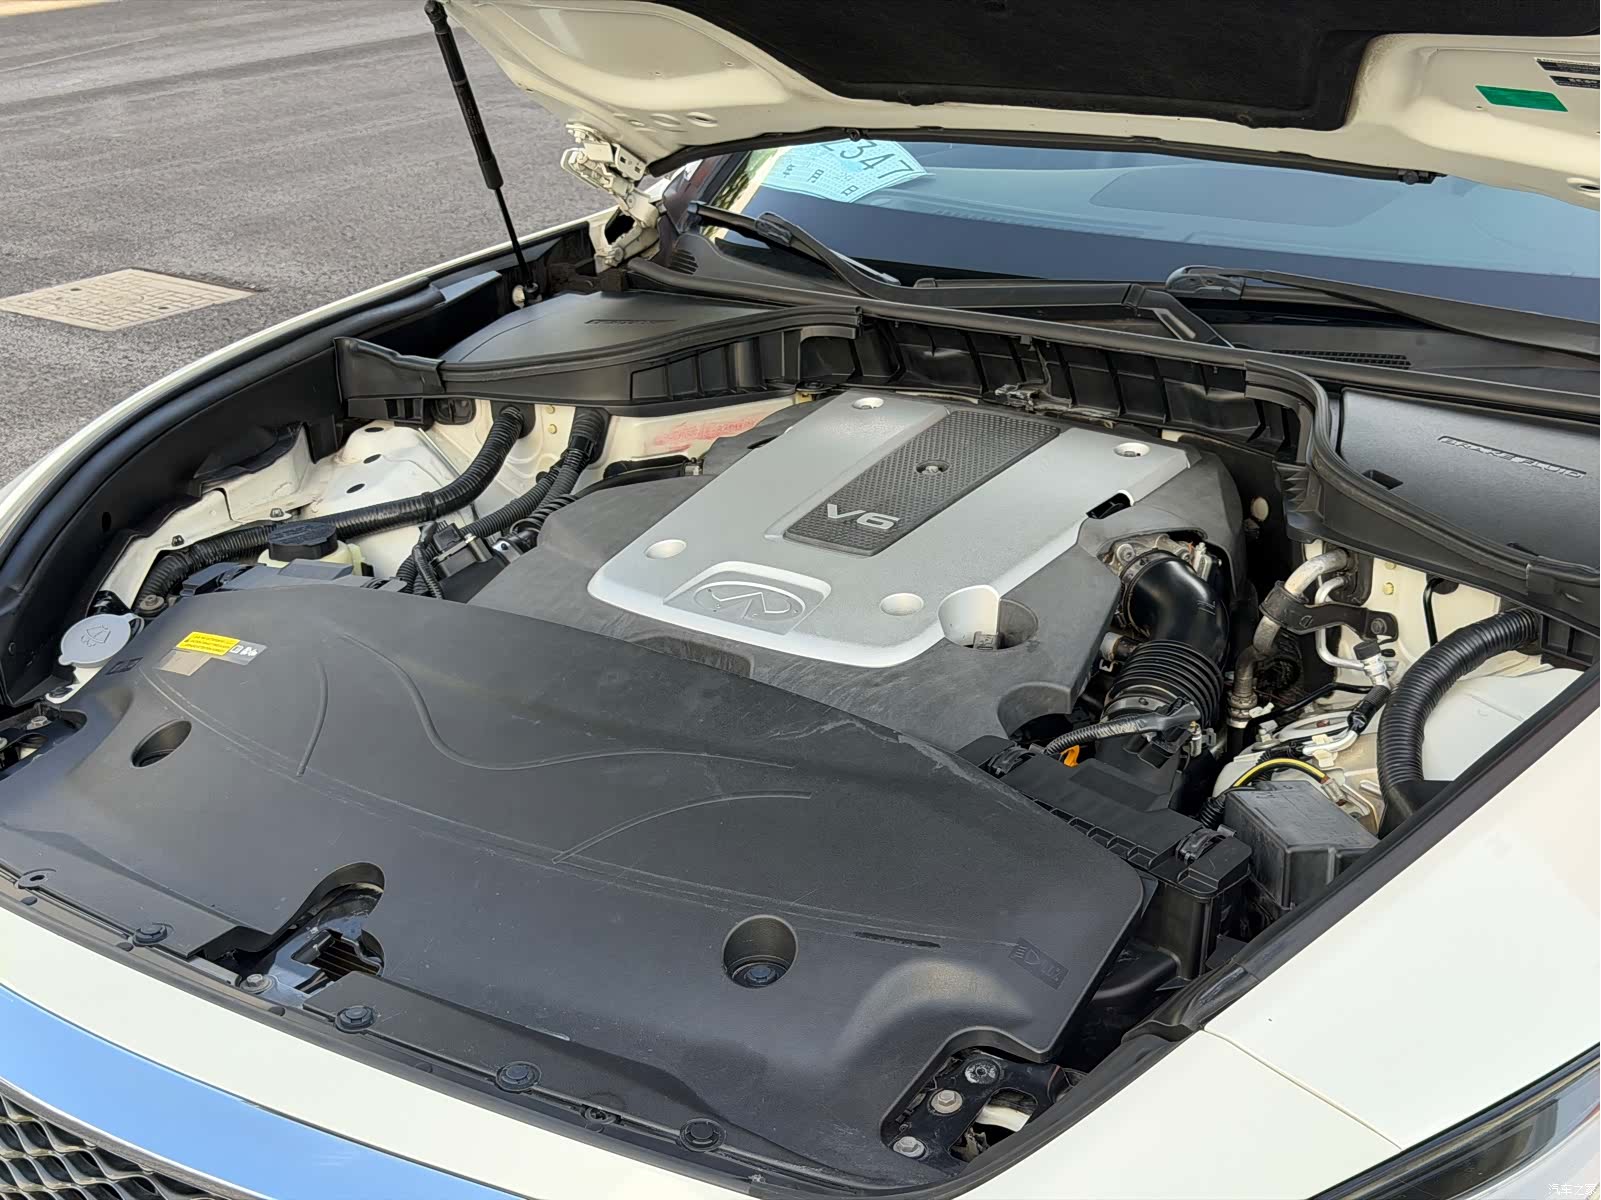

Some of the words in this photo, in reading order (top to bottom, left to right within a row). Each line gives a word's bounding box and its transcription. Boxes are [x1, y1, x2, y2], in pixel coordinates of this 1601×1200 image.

[1439, 437, 1513, 460] BRAKE
[1518, 455, 1584, 479] FLUID
[827, 503, 900, 530] V6
